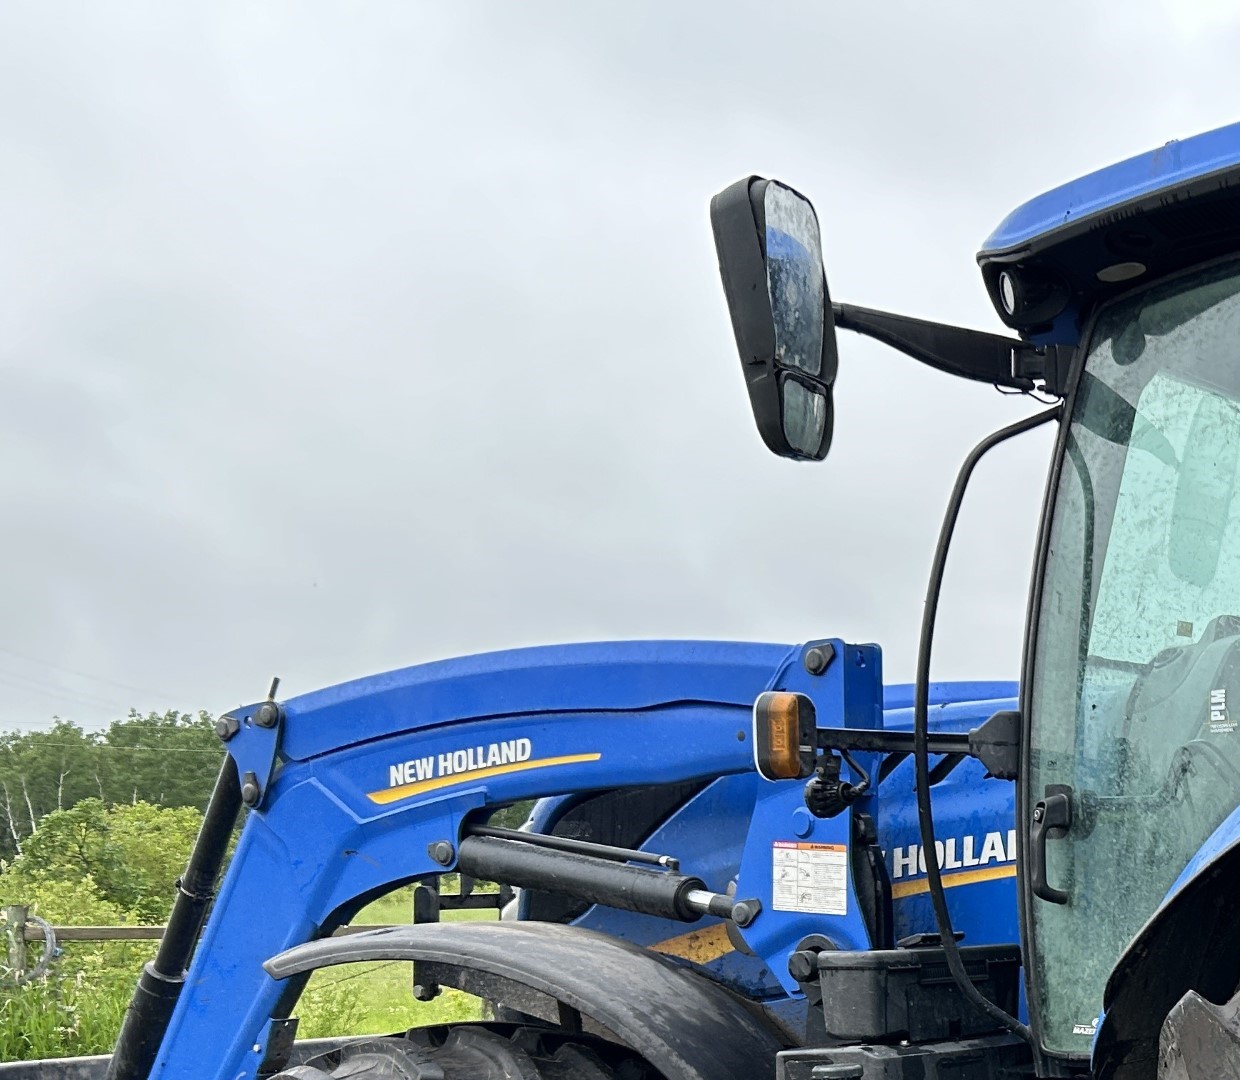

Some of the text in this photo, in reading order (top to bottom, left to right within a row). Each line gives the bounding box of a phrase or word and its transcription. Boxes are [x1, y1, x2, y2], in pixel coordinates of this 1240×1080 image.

[1210, 689, 1226, 721] PLM
[389, 738, 532, 787] NEW HOLLAND
